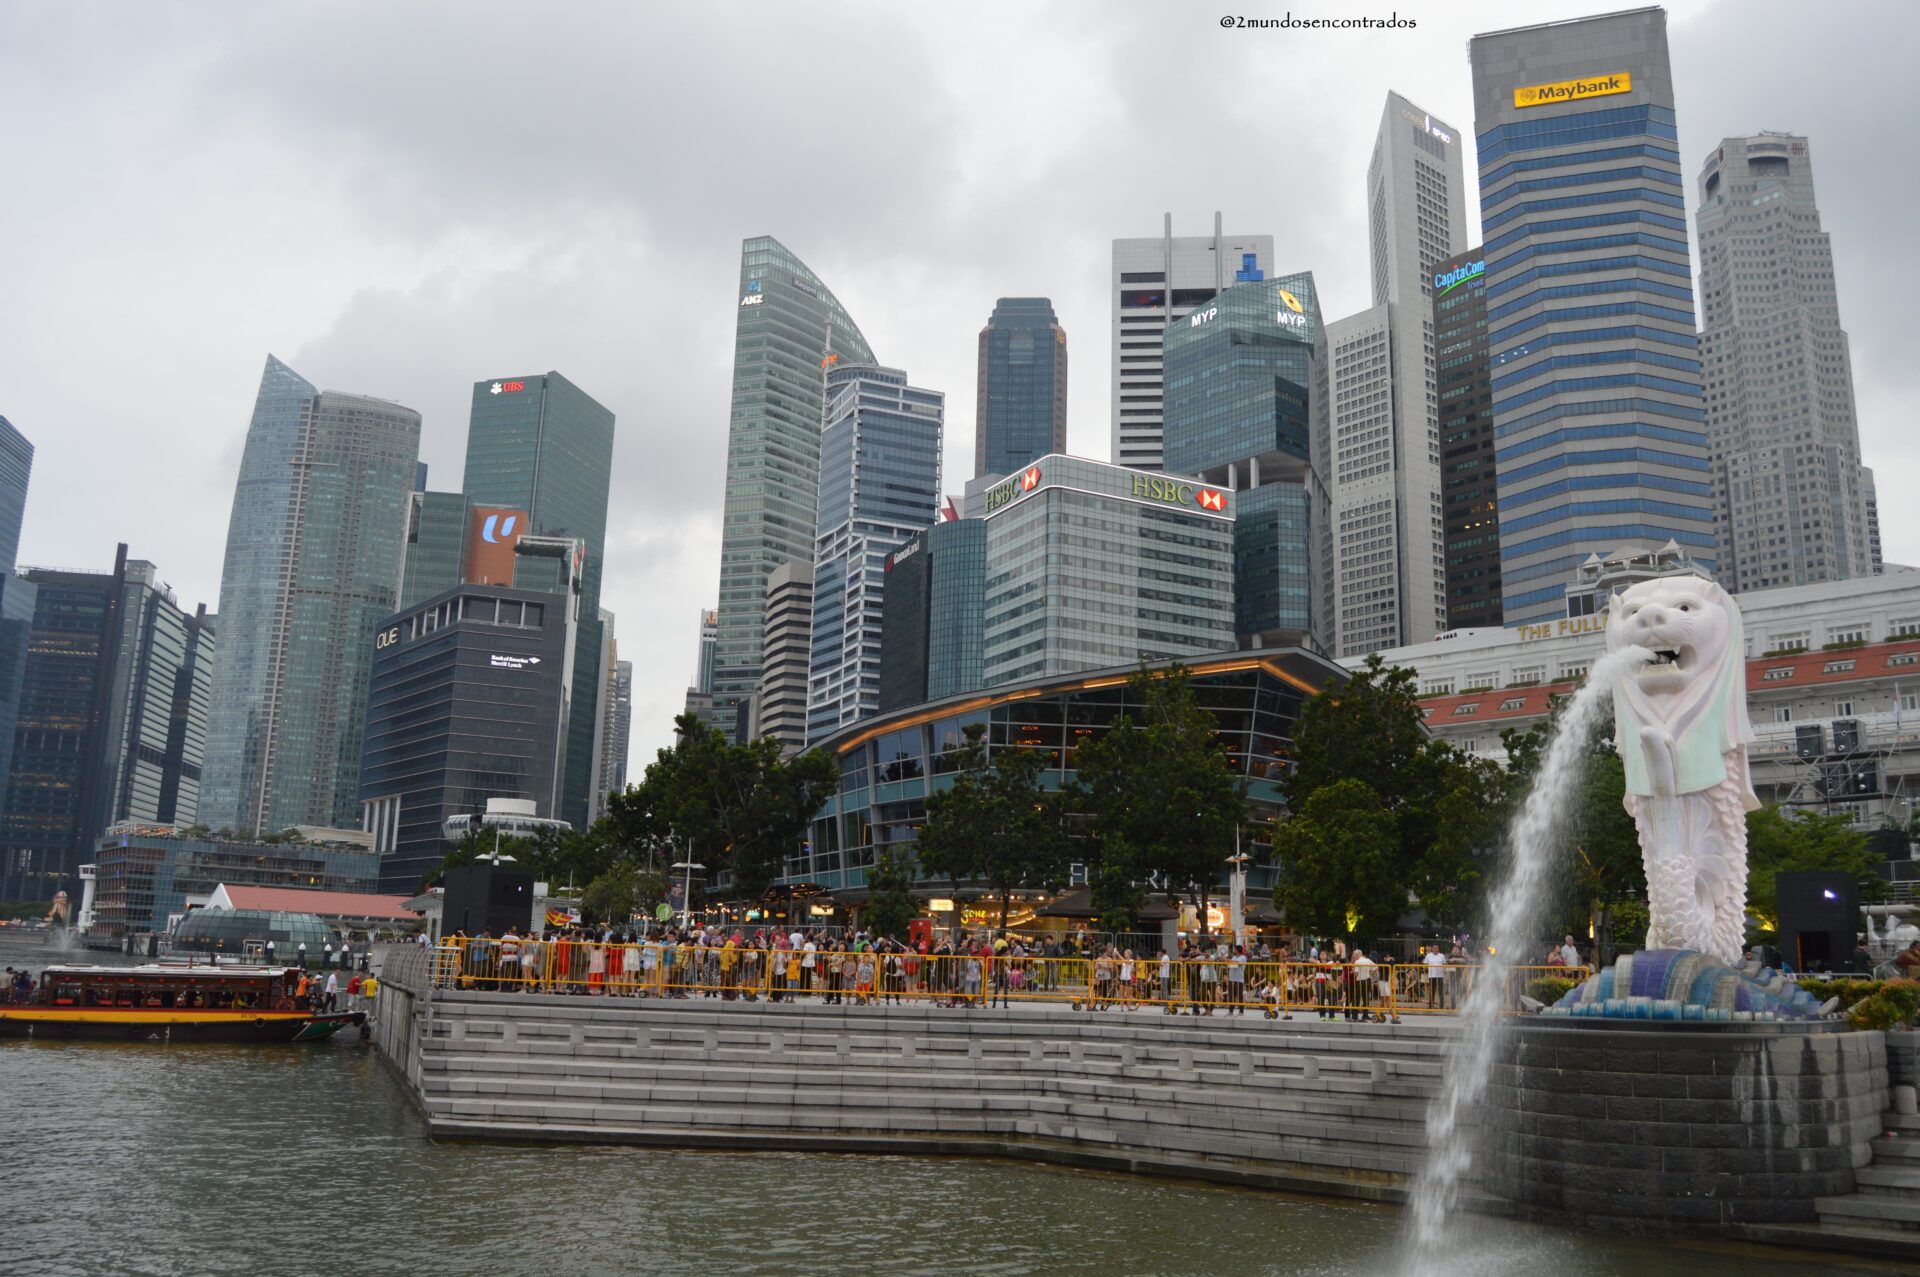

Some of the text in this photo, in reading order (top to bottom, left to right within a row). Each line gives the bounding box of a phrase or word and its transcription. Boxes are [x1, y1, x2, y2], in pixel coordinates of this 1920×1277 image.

[1538, 77, 1620, 99] Maybank
[740, 294, 763, 305] ANZ
[1191, 307, 1217, 327] MYP
[1277, 311, 1305, 326] MYP
[503, 381, 525, 393] UBS
[985, 475, 1022, 514] HSBC
[1131, 473, 1193, 506] HSBC
[376, 627, 399, 649] OUE
[1517, 623, 1551, 640] THE
